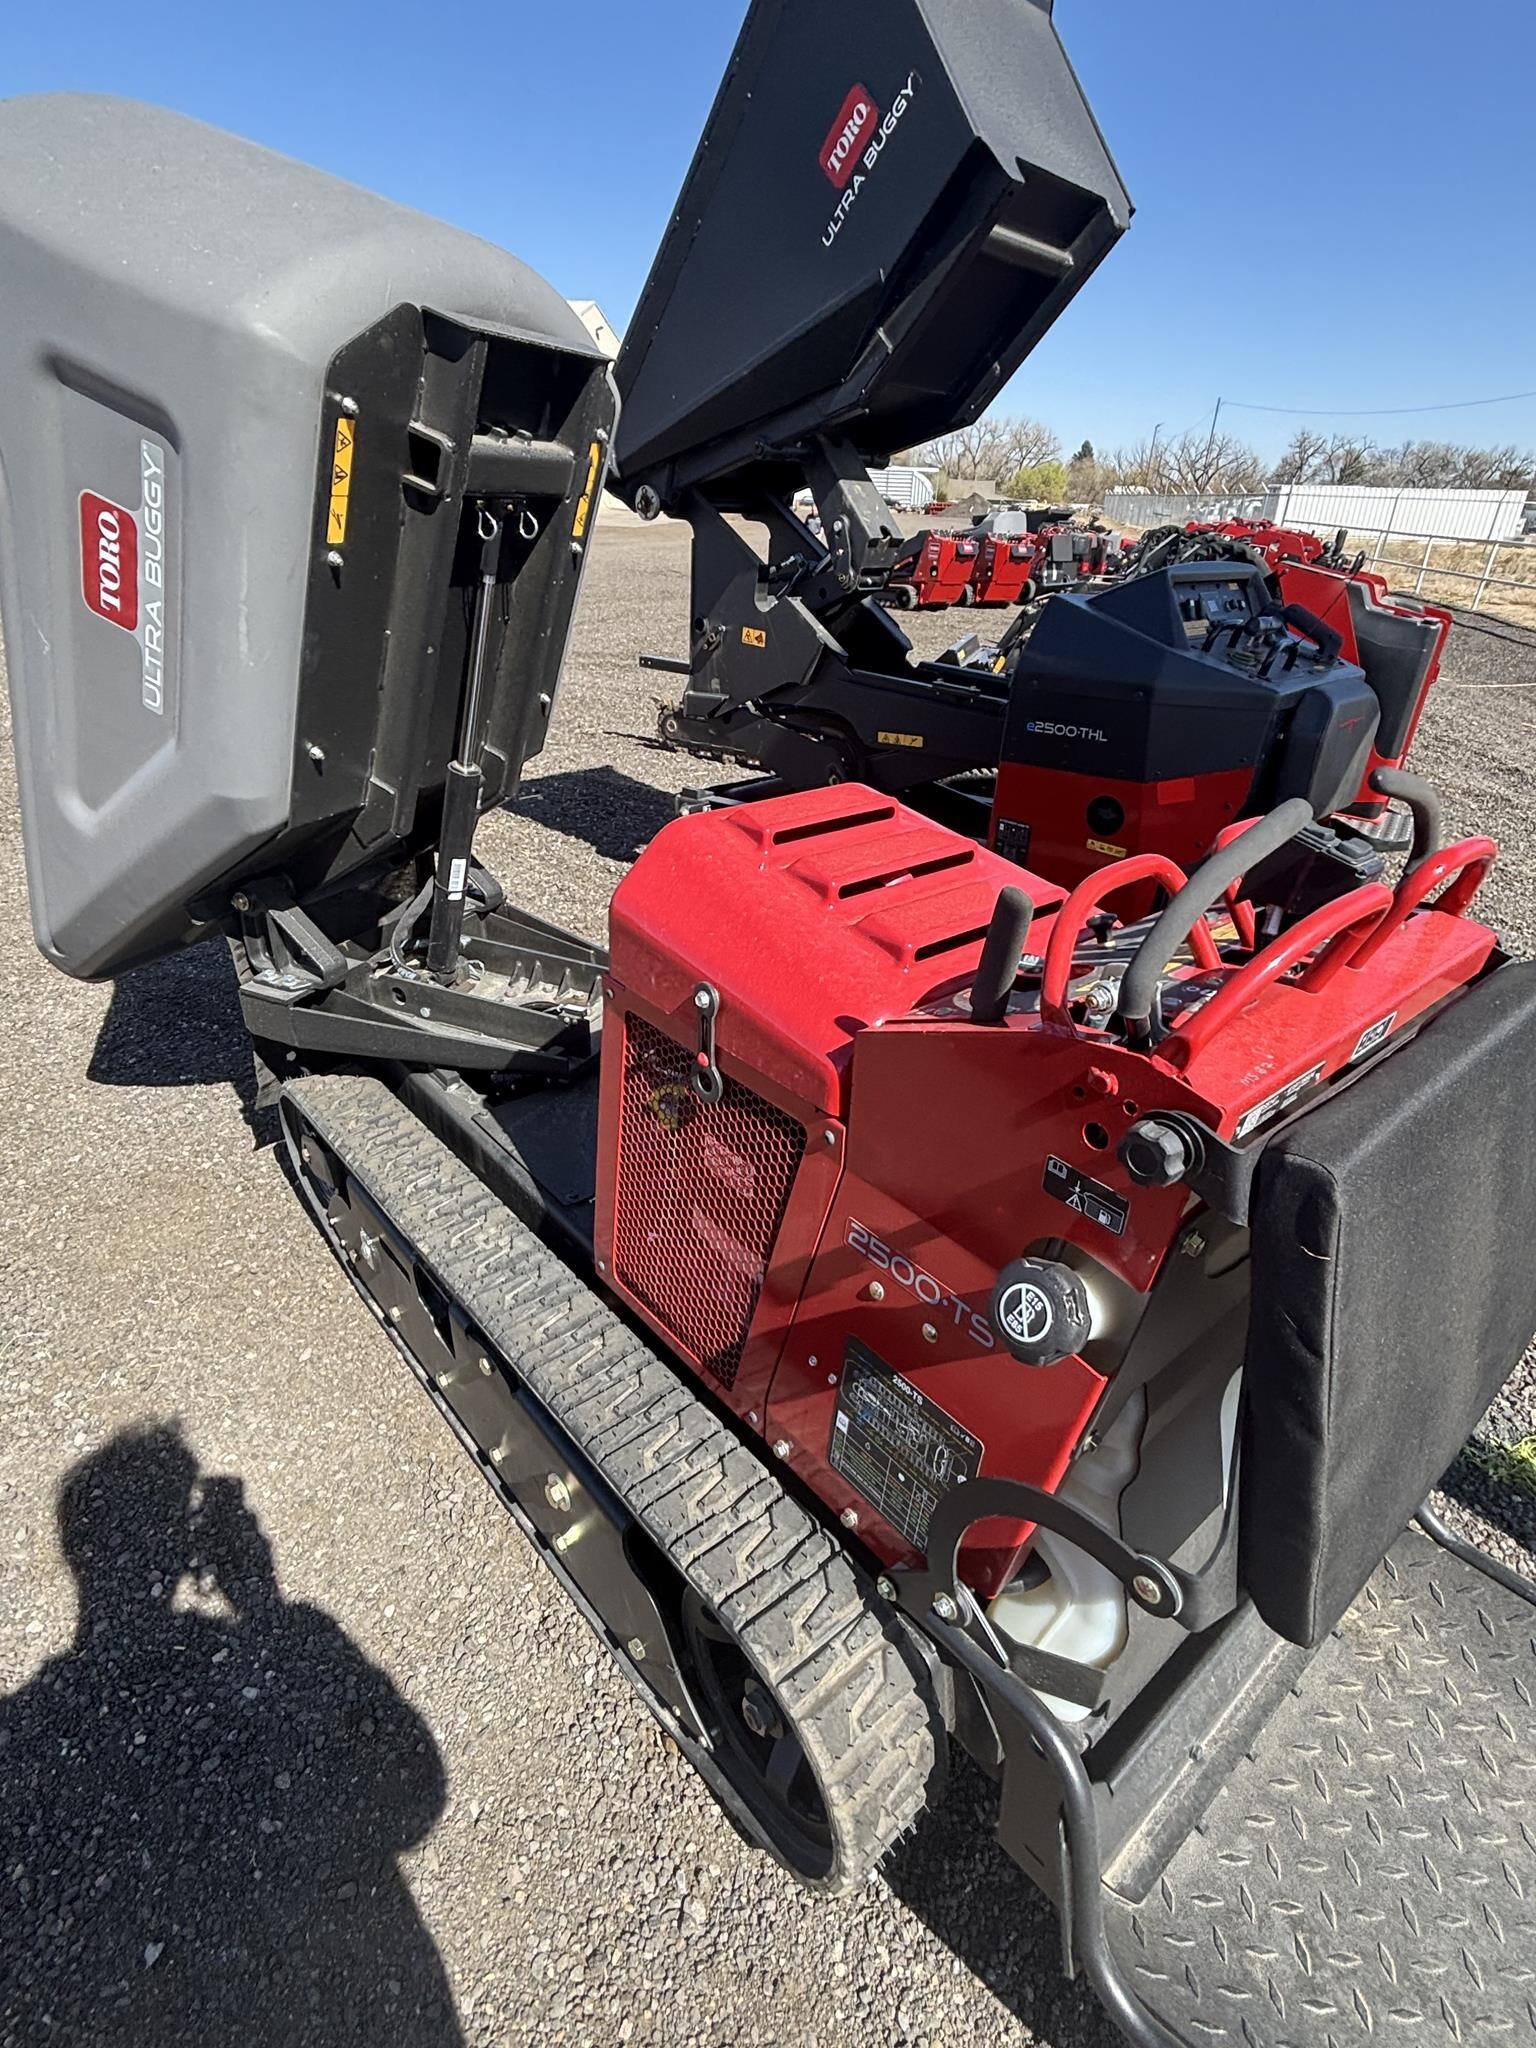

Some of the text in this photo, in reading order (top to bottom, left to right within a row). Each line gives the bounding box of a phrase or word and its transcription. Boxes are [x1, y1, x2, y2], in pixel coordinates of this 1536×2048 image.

[822, 75, 914, 246] ULTRA BUGGY
[827, 103, 867, 173] TORO
[97, 510, 120, 613] TORO
[143, 452, 162, 707] ULTRA BUGGY
[1006, 1313, 1023, 1333] E85
[1026, 1291, 1044, 1311] E15
